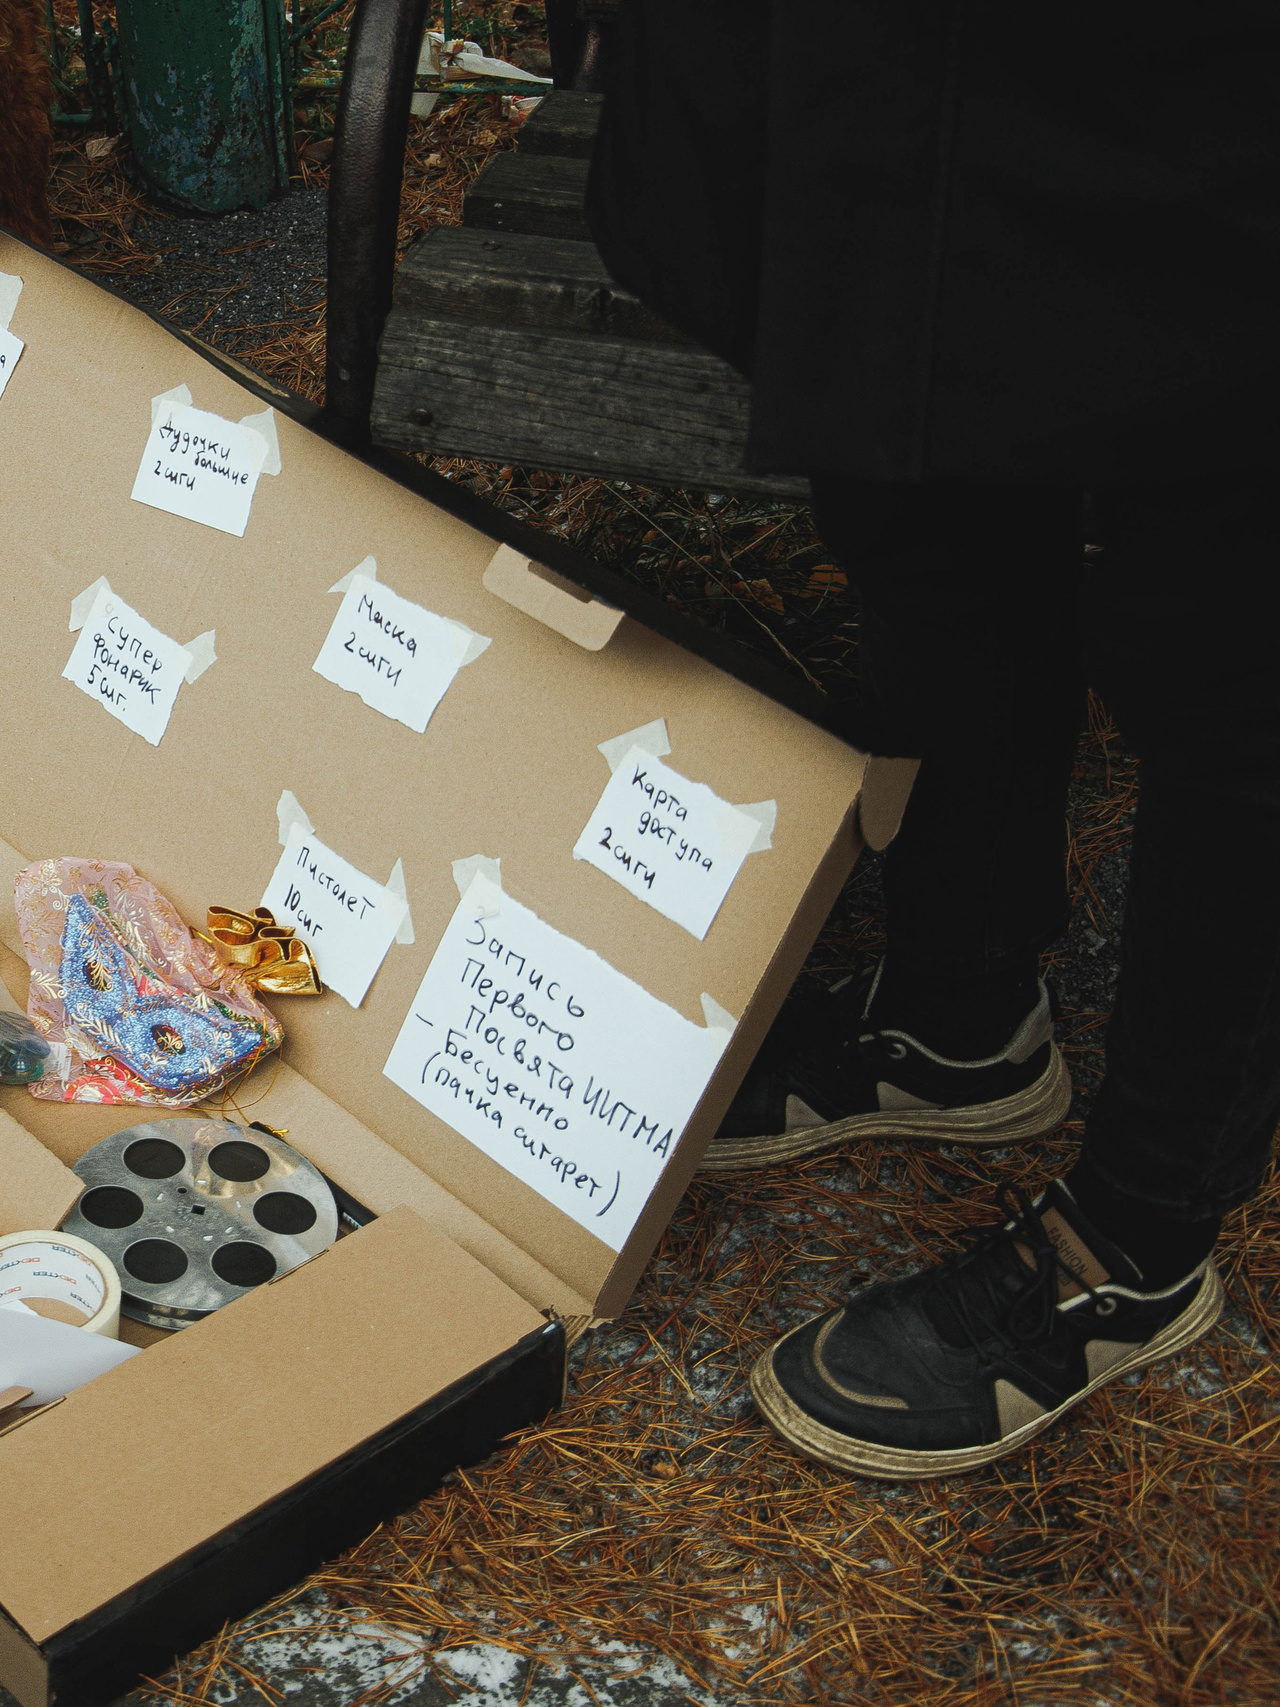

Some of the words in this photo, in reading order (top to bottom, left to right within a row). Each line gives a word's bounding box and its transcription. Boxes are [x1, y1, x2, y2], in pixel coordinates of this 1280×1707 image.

[159, 412, 231, 461] Дудочки
[194, 451, 249, 486] большие
[357, 594, 417, 658] Маска
[631, 763, 688, 821] Карта
[638, 811, 713, 872] доступа
[296, 846, 376, 920] Пистолет
[465, 905, 585, 1018] Запись
[460, 957, 575, 1052] Первого
[1047, 1227, 1088, 1276] FASHION
